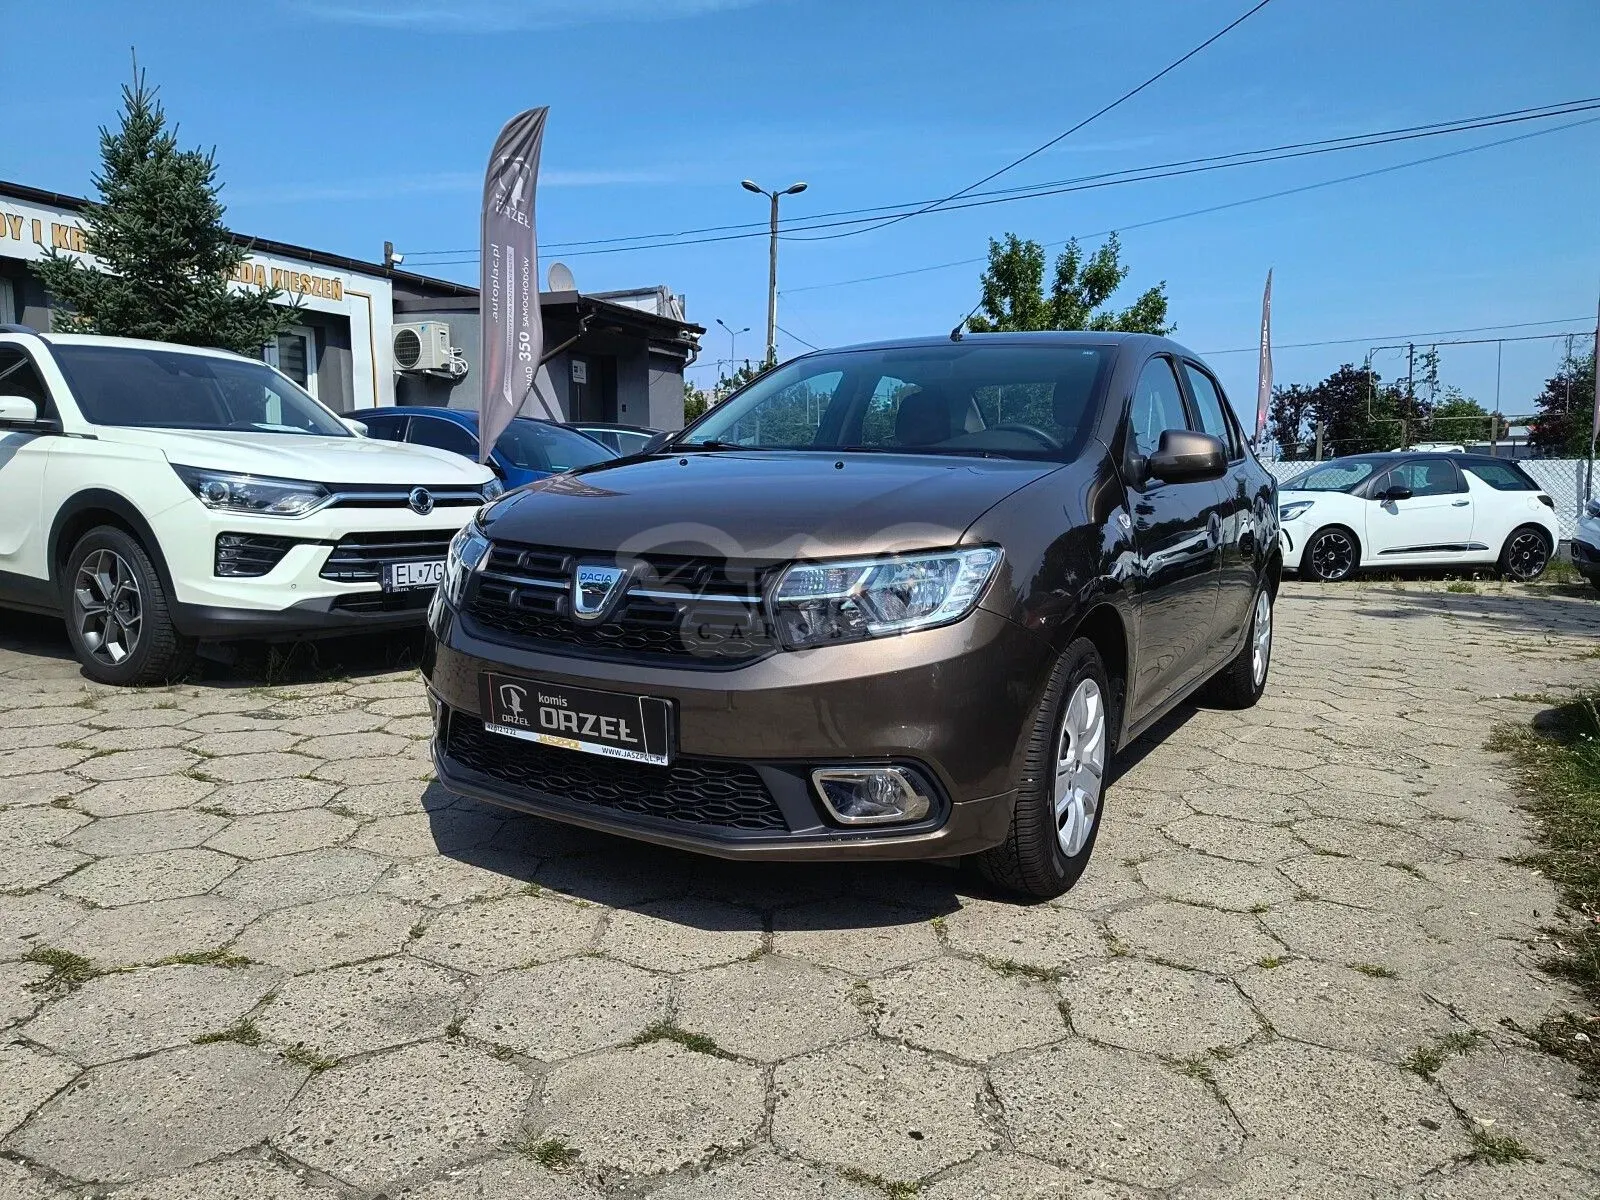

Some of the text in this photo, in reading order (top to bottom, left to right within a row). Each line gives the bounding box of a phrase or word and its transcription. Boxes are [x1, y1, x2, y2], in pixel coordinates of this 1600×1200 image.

[271, 267, 342, 301] KIESZEŃ
[522, 257, 530, 327] SAMOCHODÓW
[519, 332, 531, 361] 350
[396, 563, 445, 584] EL 7G
[580, 573, 612, 582] DACIA
[538, 691, 568, 707] komis
[502, 713, 530, 726] ORZEŁ
[540, 706, 638, 743] ORZEŁ
